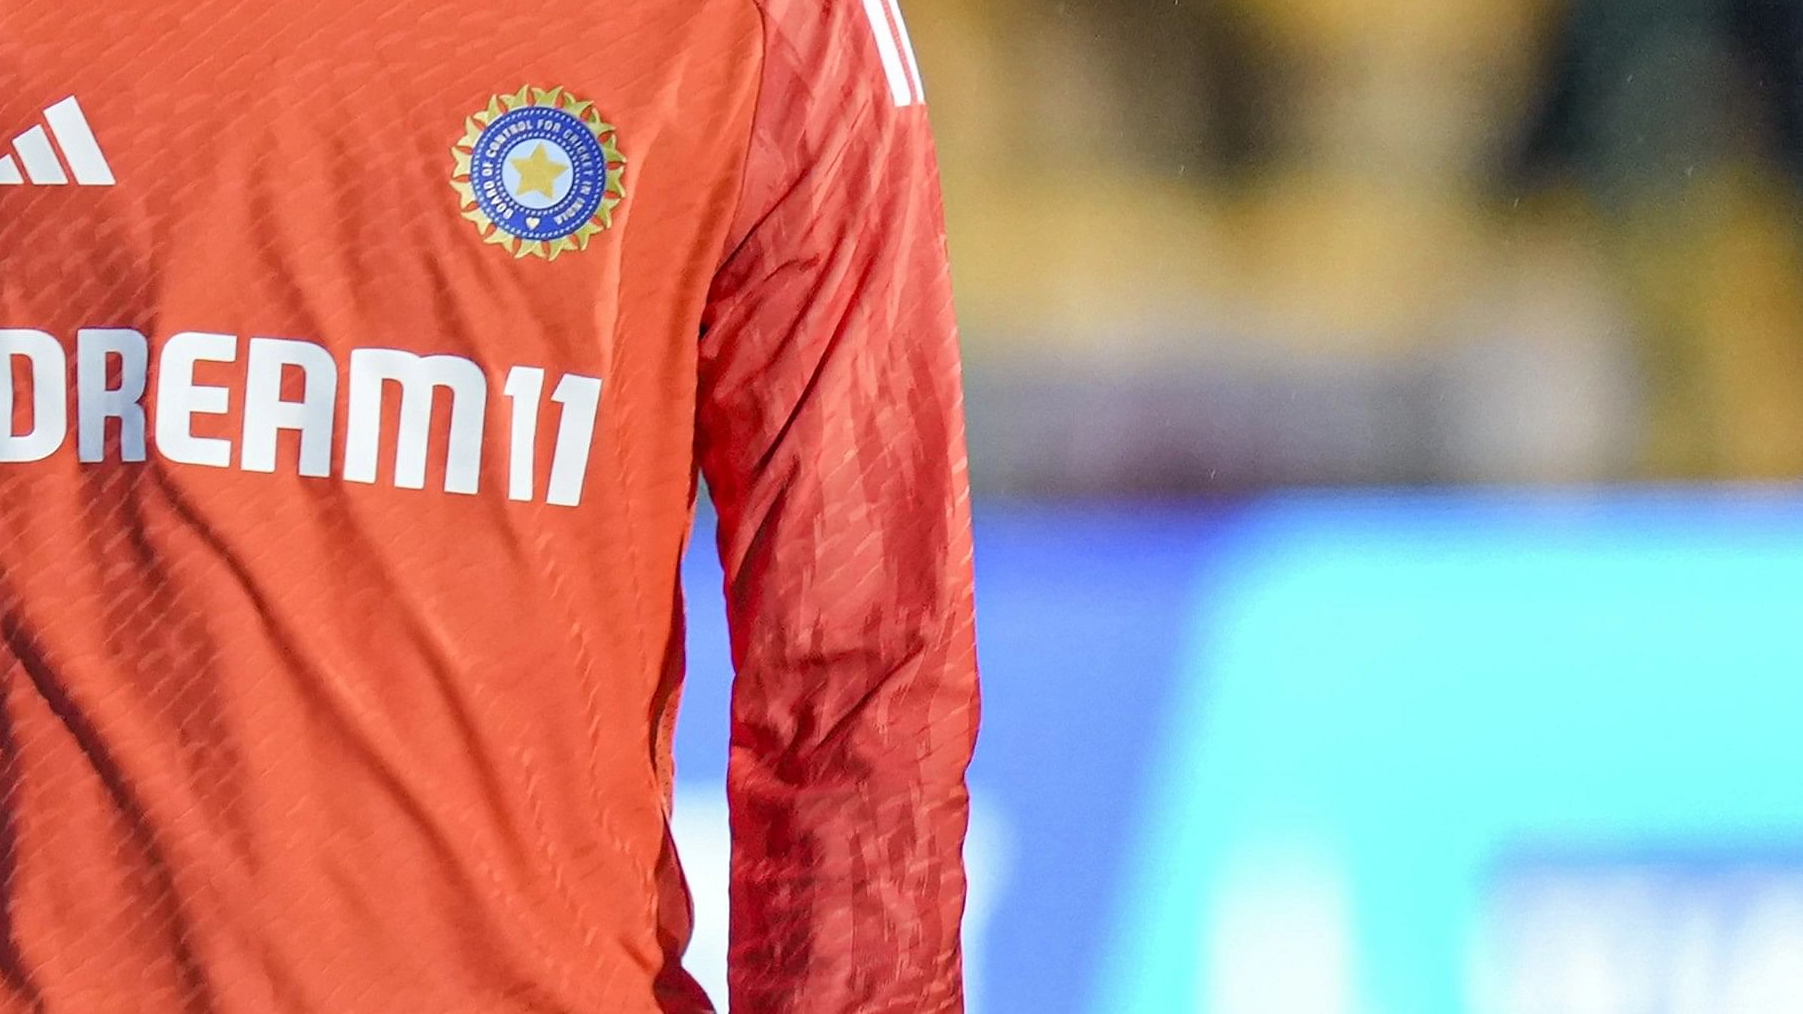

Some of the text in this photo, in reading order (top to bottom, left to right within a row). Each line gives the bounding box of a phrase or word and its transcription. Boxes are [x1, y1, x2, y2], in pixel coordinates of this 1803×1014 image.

[482, 118, 594, 225] BOARD OF CONTROL FOR CRICKET IN INDIA
